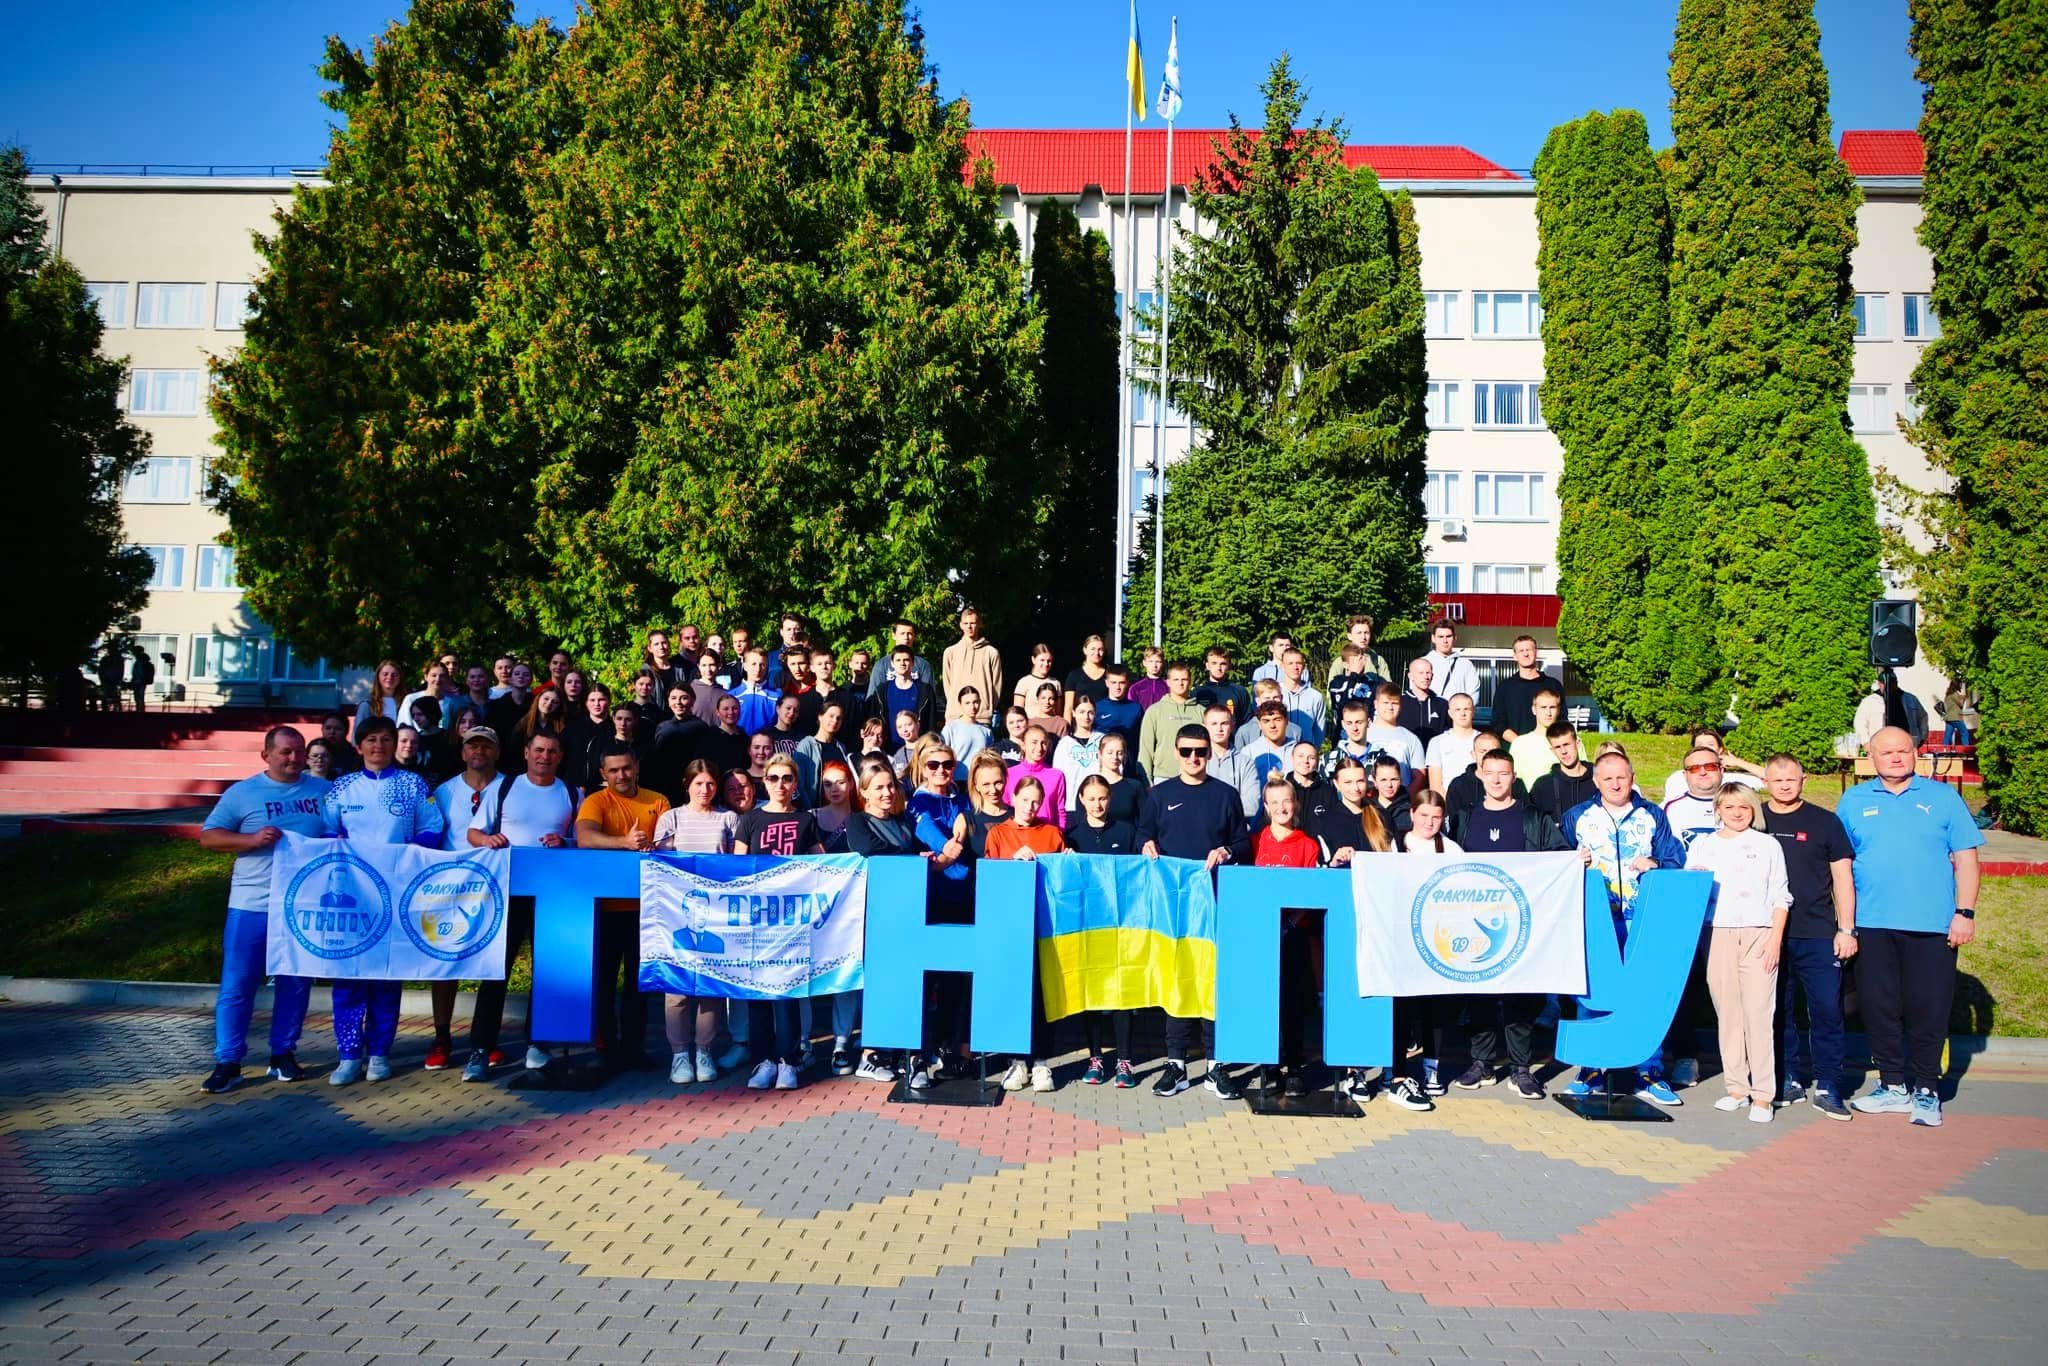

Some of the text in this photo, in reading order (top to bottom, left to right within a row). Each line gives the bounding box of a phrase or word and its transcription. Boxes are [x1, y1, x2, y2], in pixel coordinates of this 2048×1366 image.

[265, 798, 321, 820] FRANCE
[422, 880, 486, 896] ФАКУЛЬТЕТ
[1431, 889, 1508, 903] ФАКУЛЬТЕТ
[718, 890, 841, 930] ТНПУ
[297, 909, 380, 937] ТНПУ
[702, 956, 811, 971] www.tnpu.edu.ua
